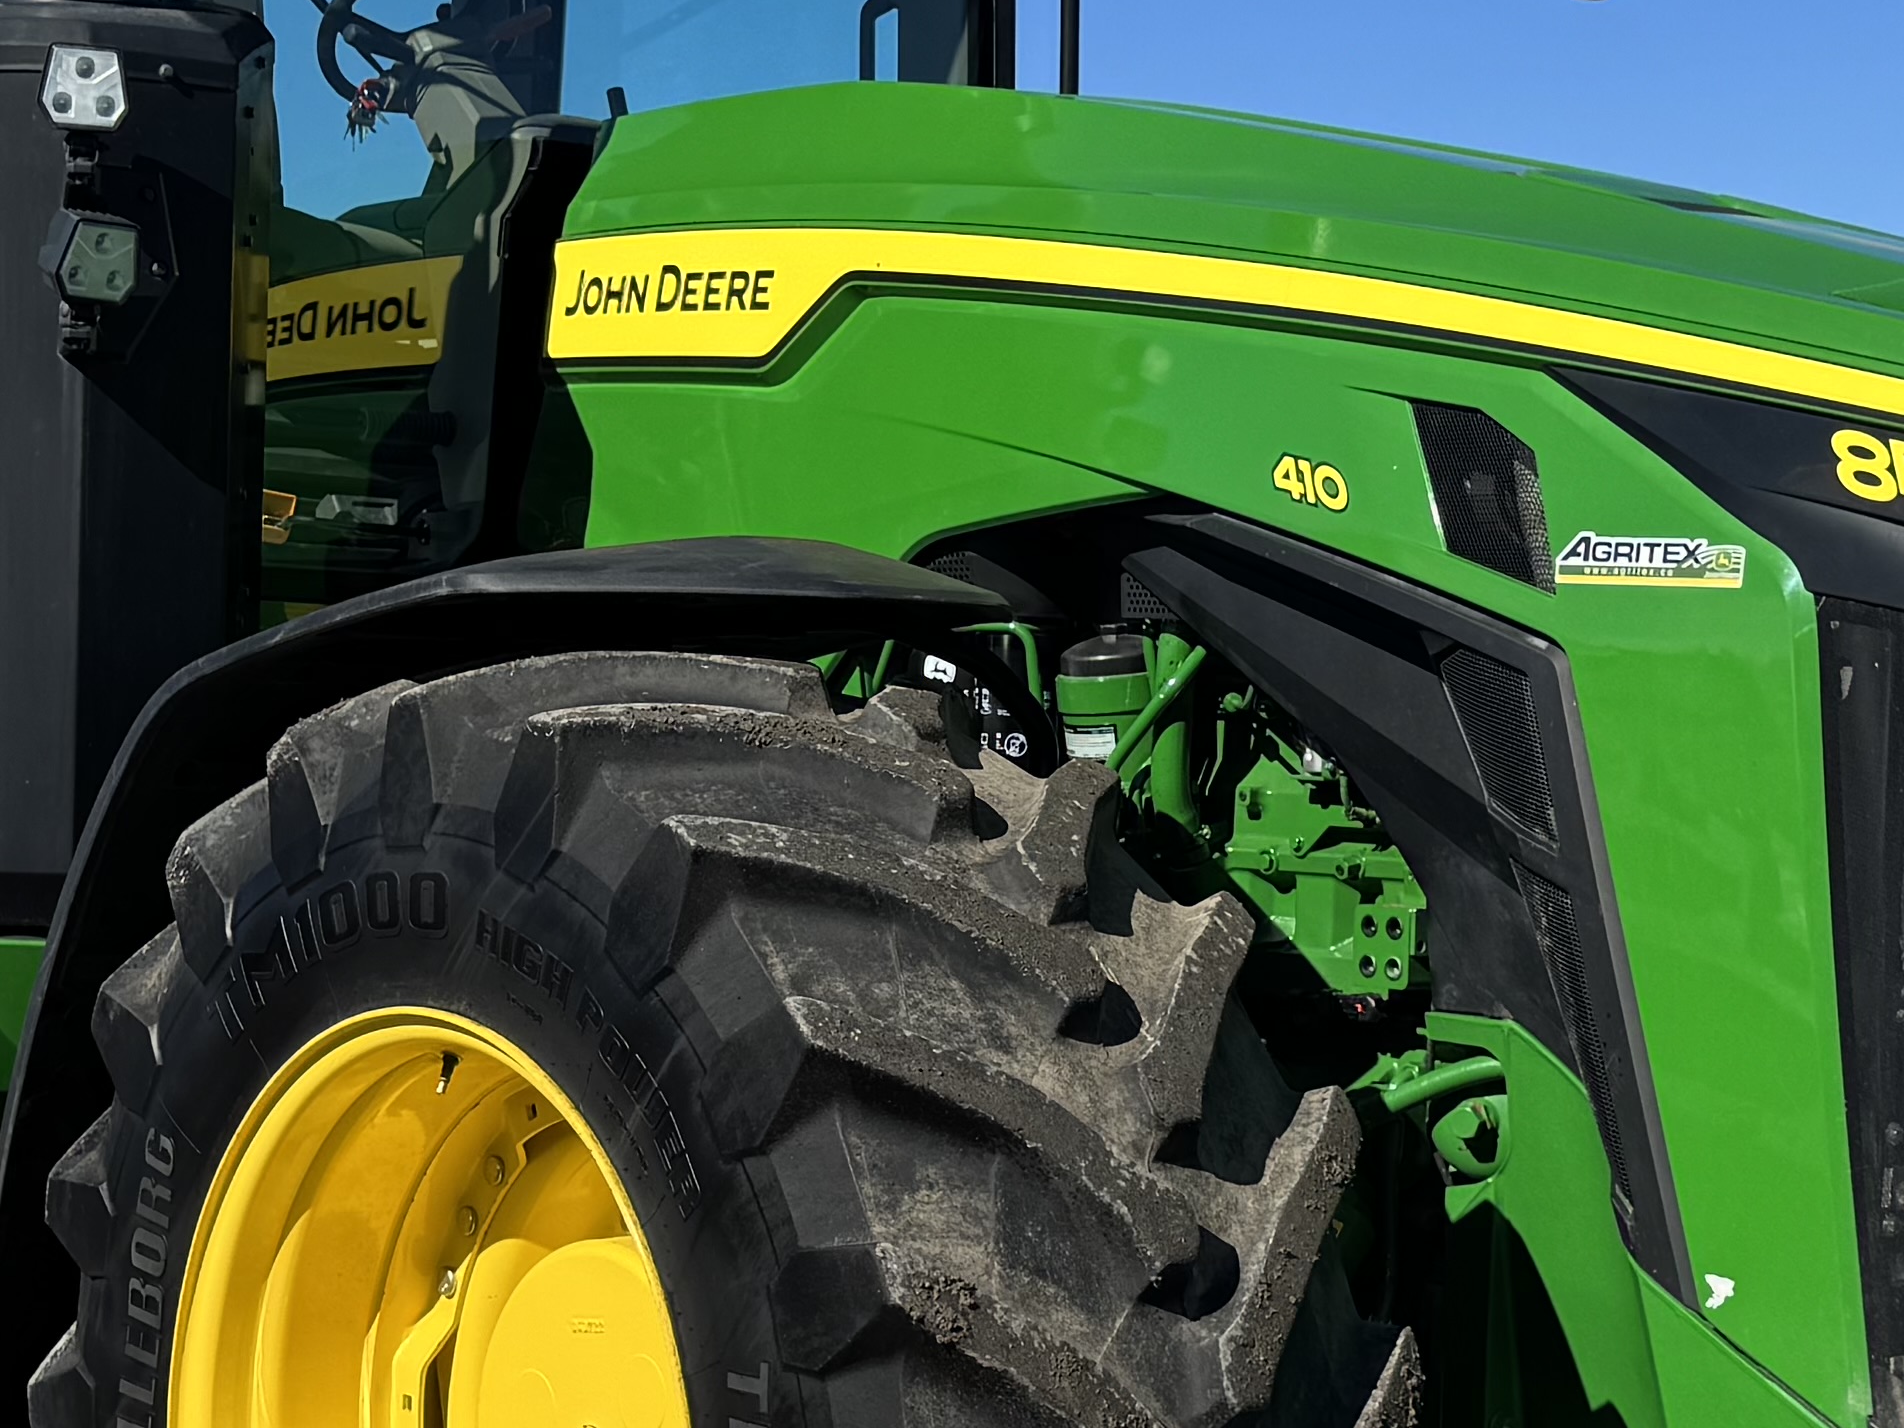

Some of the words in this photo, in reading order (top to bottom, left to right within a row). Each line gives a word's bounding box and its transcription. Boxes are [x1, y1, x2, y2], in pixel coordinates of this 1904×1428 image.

[565, 269, 649, 317] JOHN
[655, 265, 775, 313] DEERE
[1271, 453, 1349, 512] 410
[1561, 536, 1703, 565] AGRITEX
[206, 869, 450, 1044] TM1000
[474, 907, 575, 1012] HIGH
[576, 985, 703, 1221] POWER
